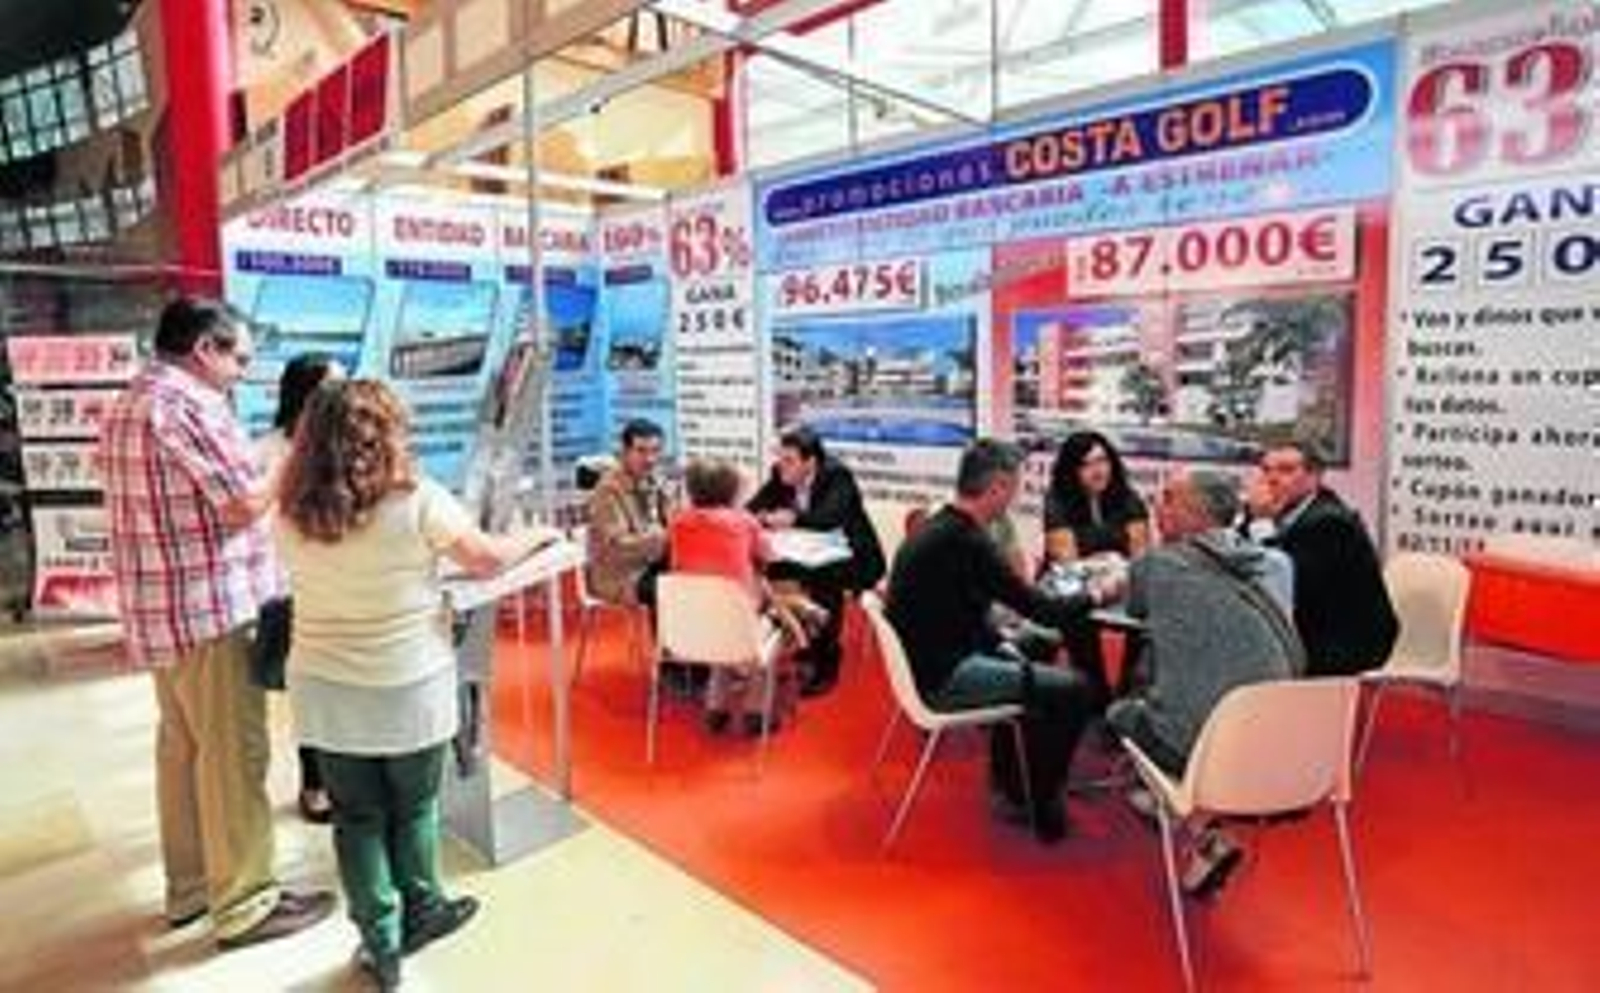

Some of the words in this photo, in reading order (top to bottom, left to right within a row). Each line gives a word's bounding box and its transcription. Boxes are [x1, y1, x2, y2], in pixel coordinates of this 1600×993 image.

[1006, 122, 1141, 178] COSTA
[1157, 86, 1290, 151] GOLF
[672, 214, 749, 277] 63%
[1091, 216, 1338, 281] 87.000€
[686, 284, 737, 303] GANA
[782, 262, 916, 305] 96.475€
[1540, 306, 1584, 327] que
[1511, 370, 1541, 385] un
